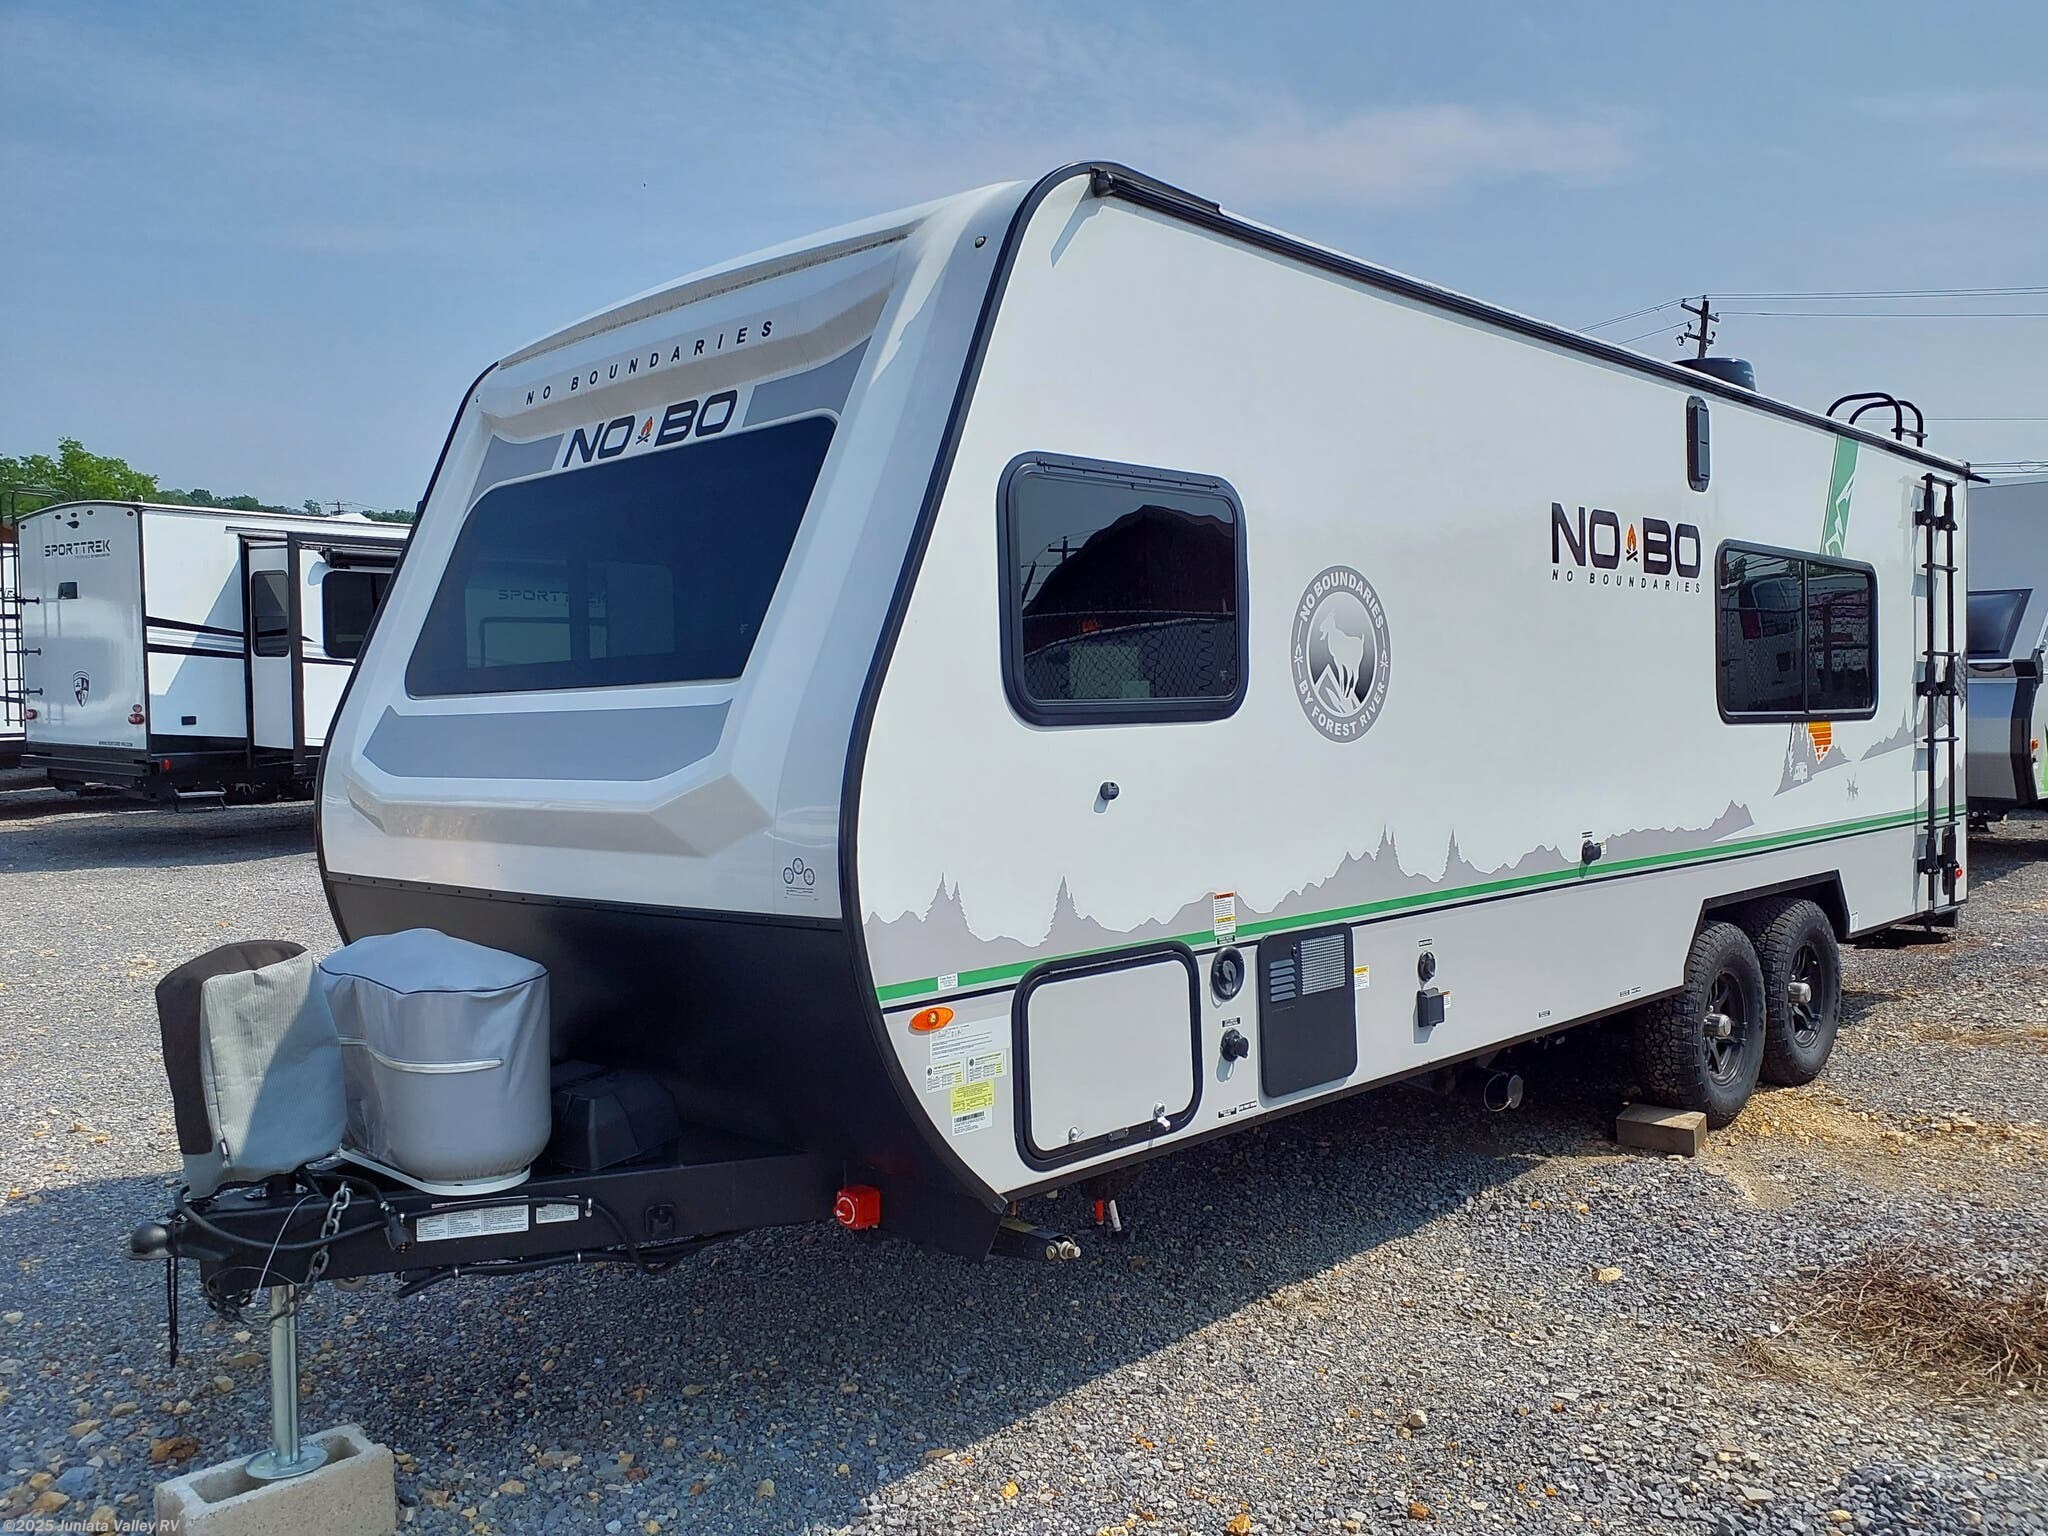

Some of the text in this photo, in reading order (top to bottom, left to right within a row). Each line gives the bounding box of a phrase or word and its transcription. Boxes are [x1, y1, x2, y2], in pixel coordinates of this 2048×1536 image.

[525, 320, 773, 406] NO BOUNDARIES
[44, 539, 111, 557] SPORTTREK
[1299, 571, 1384, 629] NO BOUNDARIES
[1551, 568, 1701, 593] NO BOUNDARIES
[1298, 680, 1386, 736] BY FOREST RIVER
